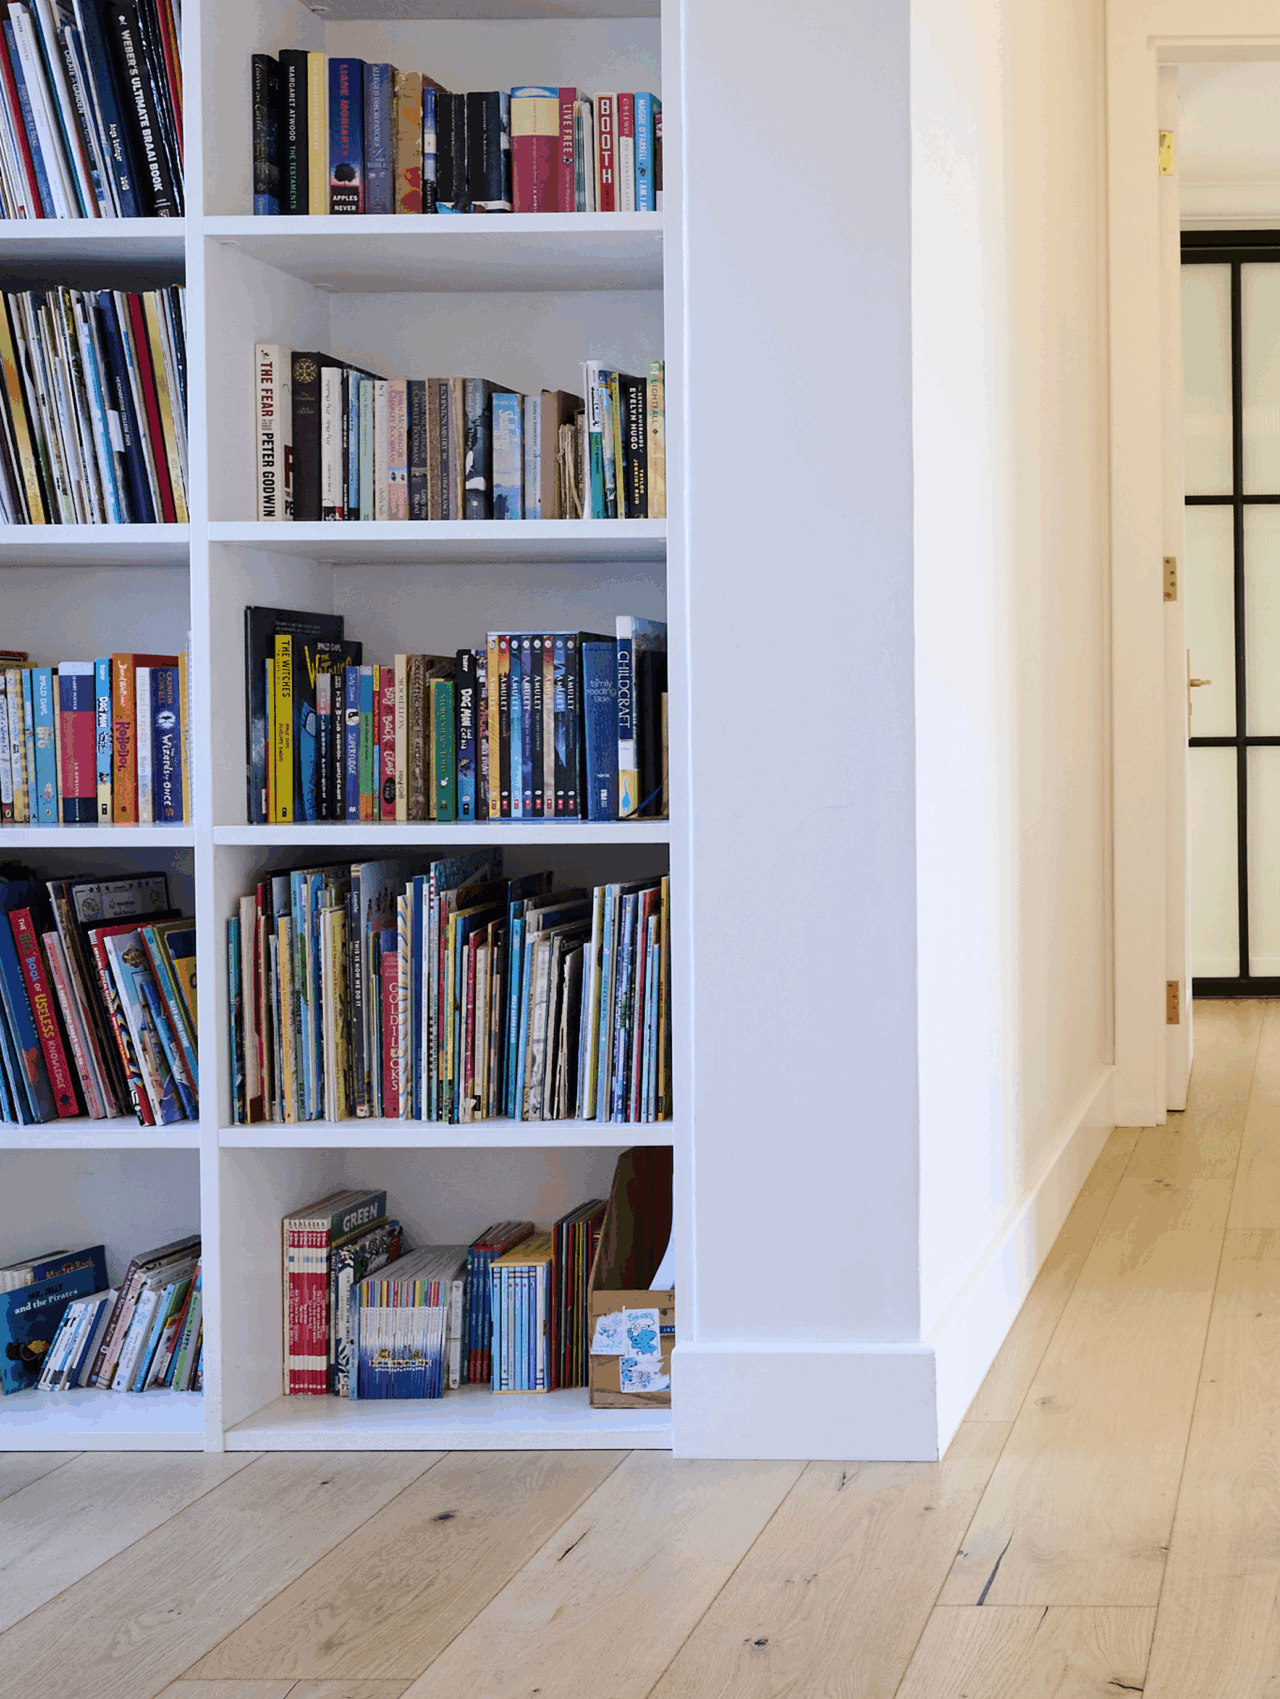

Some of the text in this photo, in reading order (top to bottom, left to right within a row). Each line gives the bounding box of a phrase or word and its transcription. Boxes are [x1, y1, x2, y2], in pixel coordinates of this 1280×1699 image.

[64, 50, 77, 76] CREATE
[72, 83, 84, 114] GARDEN
[288, 66, 296, 108] MARGARET
[121, 30, 163, 191] WEBER'S ULTIMATE BRAAI BOOK
[340, 64, 349, 156] LIANE MORIARTY
[563, 104, 573, 154] LIVE FREE
[601, 99, 612, 184] BOOTH
[638, 99, 649, 161] MAGGIE O'FARRELL
[115, 376, 130, 434] HERONBRIDGE COLLEGE
[412, 390, 420, 422] CHARLEY
[651, 379, 660, 425] LIGHTFALL
[261, 362, 275, 517] THE FEAR PETER GODWIN
[630, 424, 638, 450] HUGO
[281, 640, 290, 659] THE
[282, 660, 291, 698] WITCHES
[500, 676, 508, 711] AMULET
[511, 676, 519, 711] AMULET
[523, 676, 531, 711] AMULET
[534, 675, 542, 710] AMULET
[556, 675, 564, 710] AMULET
[567, 675, 575, 710] AMULET
[618, 650, 631, 729] CHILDCRAFT
[36, 675, 50, 749] ROALD DAHL BFG
[98, 697, 109, 711] DOG
[98, 712, 109, 728] MAN
[460, 689, 473, 727] DOG MAN
[479, 700, 487, 737] WHOLE
[347, 733, 356, 774] SUPERFUDGE
[94, 947, 102, 970] AMAZING
[355, 980, 361, 989] WE
[355, 990, 361, 1000] DO
[18, 918, 27, 931] THE
[35, 993, 55, 1038] USELESS
[47, 1040, 66, 1089] KNOWLEDGE
[343, 1201, 378, 1233] GREEN
[14, 1288, 79, 1315] and the Pirates
